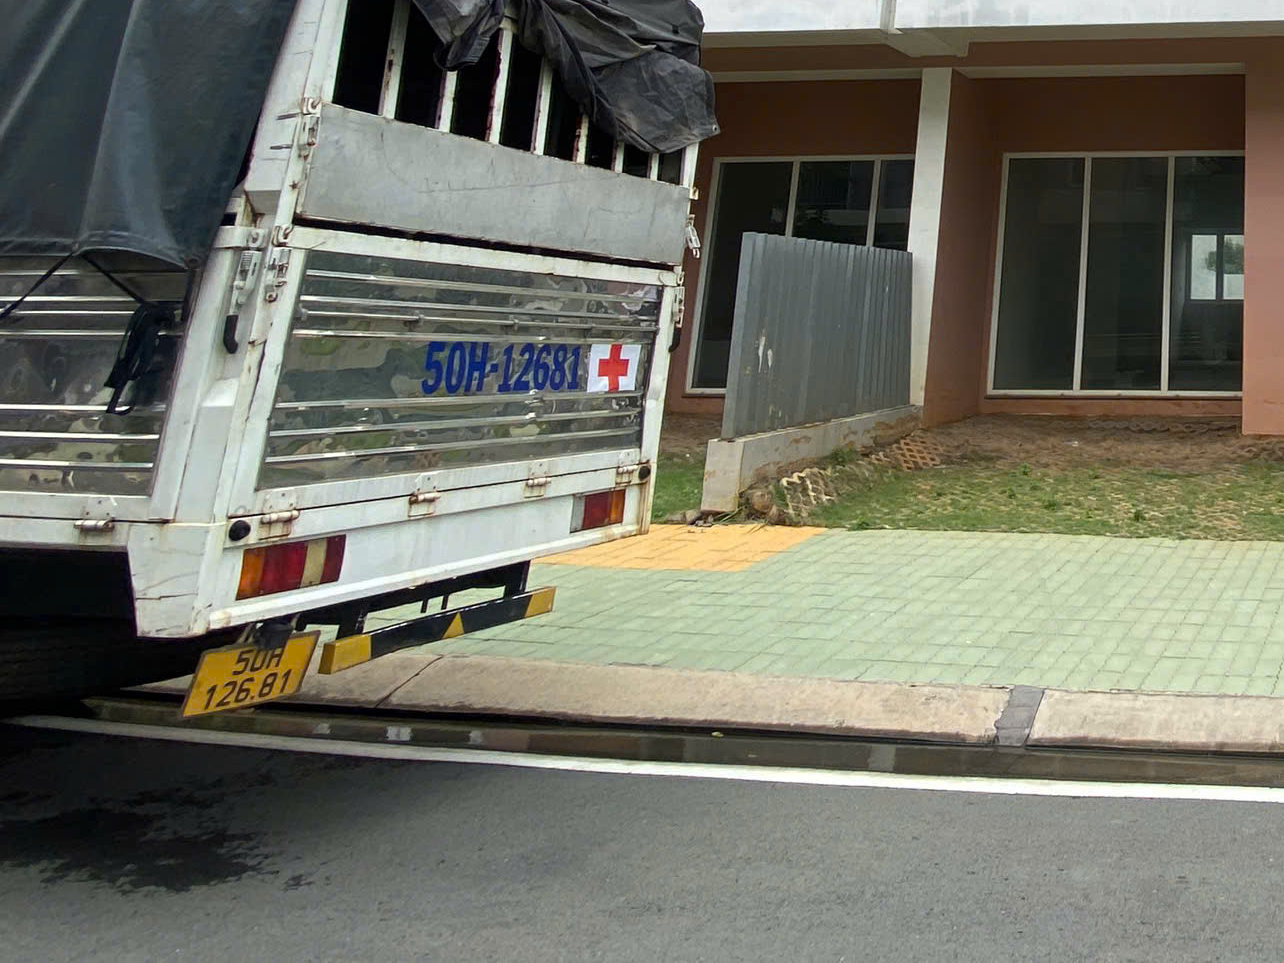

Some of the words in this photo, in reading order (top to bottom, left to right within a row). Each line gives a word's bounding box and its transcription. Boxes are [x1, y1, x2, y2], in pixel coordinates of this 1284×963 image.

[421, 341, 582, 394] 50H-12681
[232, 648, 283, 676] 50H
[205, 669, 292, 710] 126.81
